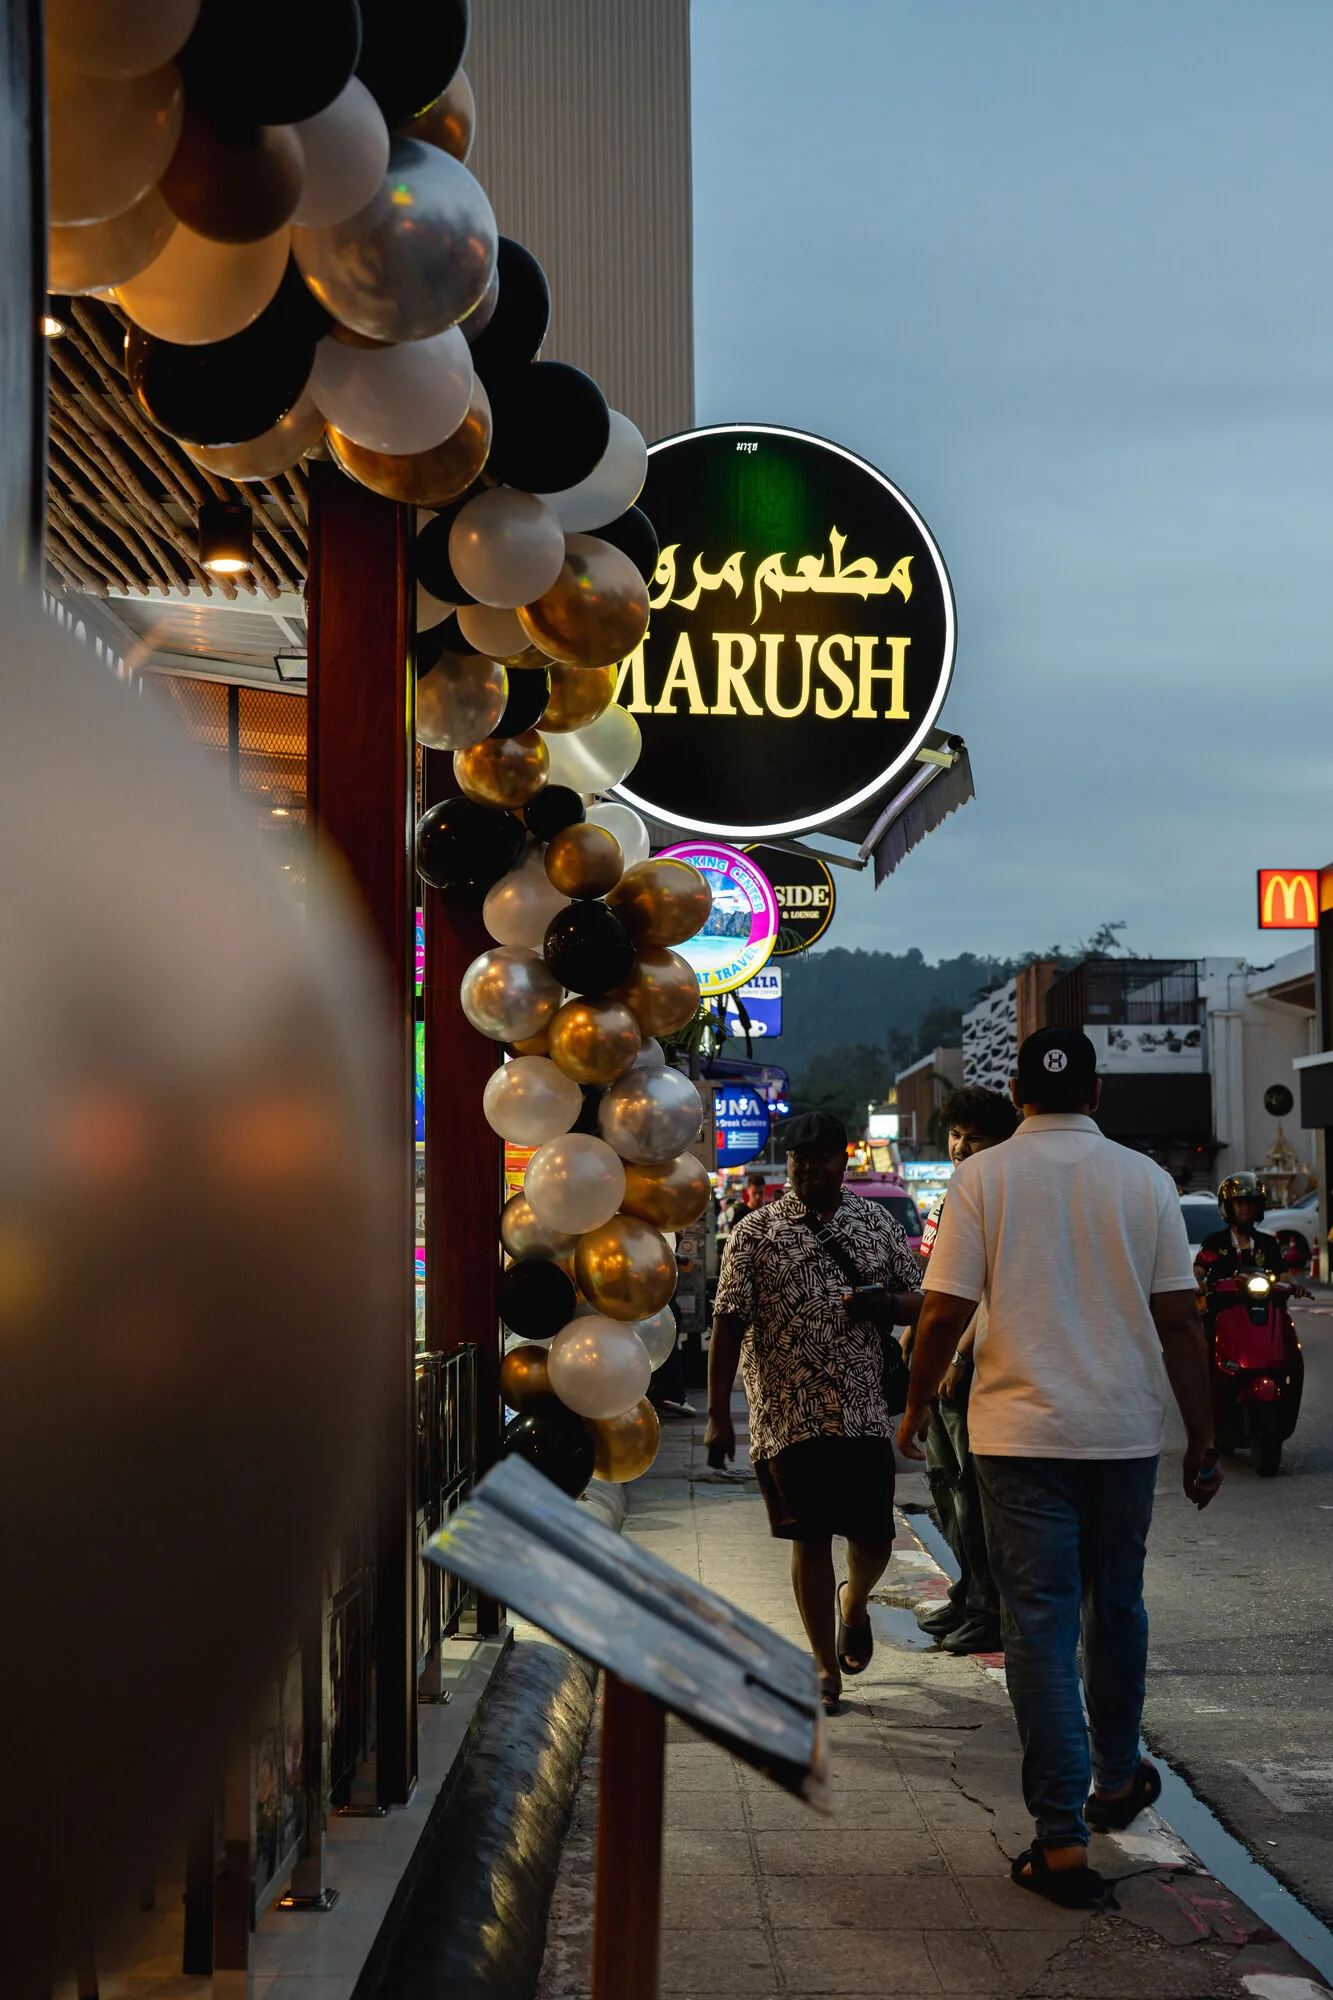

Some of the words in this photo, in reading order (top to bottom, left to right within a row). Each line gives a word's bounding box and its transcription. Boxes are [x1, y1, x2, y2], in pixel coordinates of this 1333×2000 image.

[751, 525, 915, 625] مطعم
[730, 867, 765, 913] CENTER
[774, 885, 829, 907] SIDE
[790, 910, 820, 919] LOUNGE
[714, 947, 759, 981] TRAVEL
